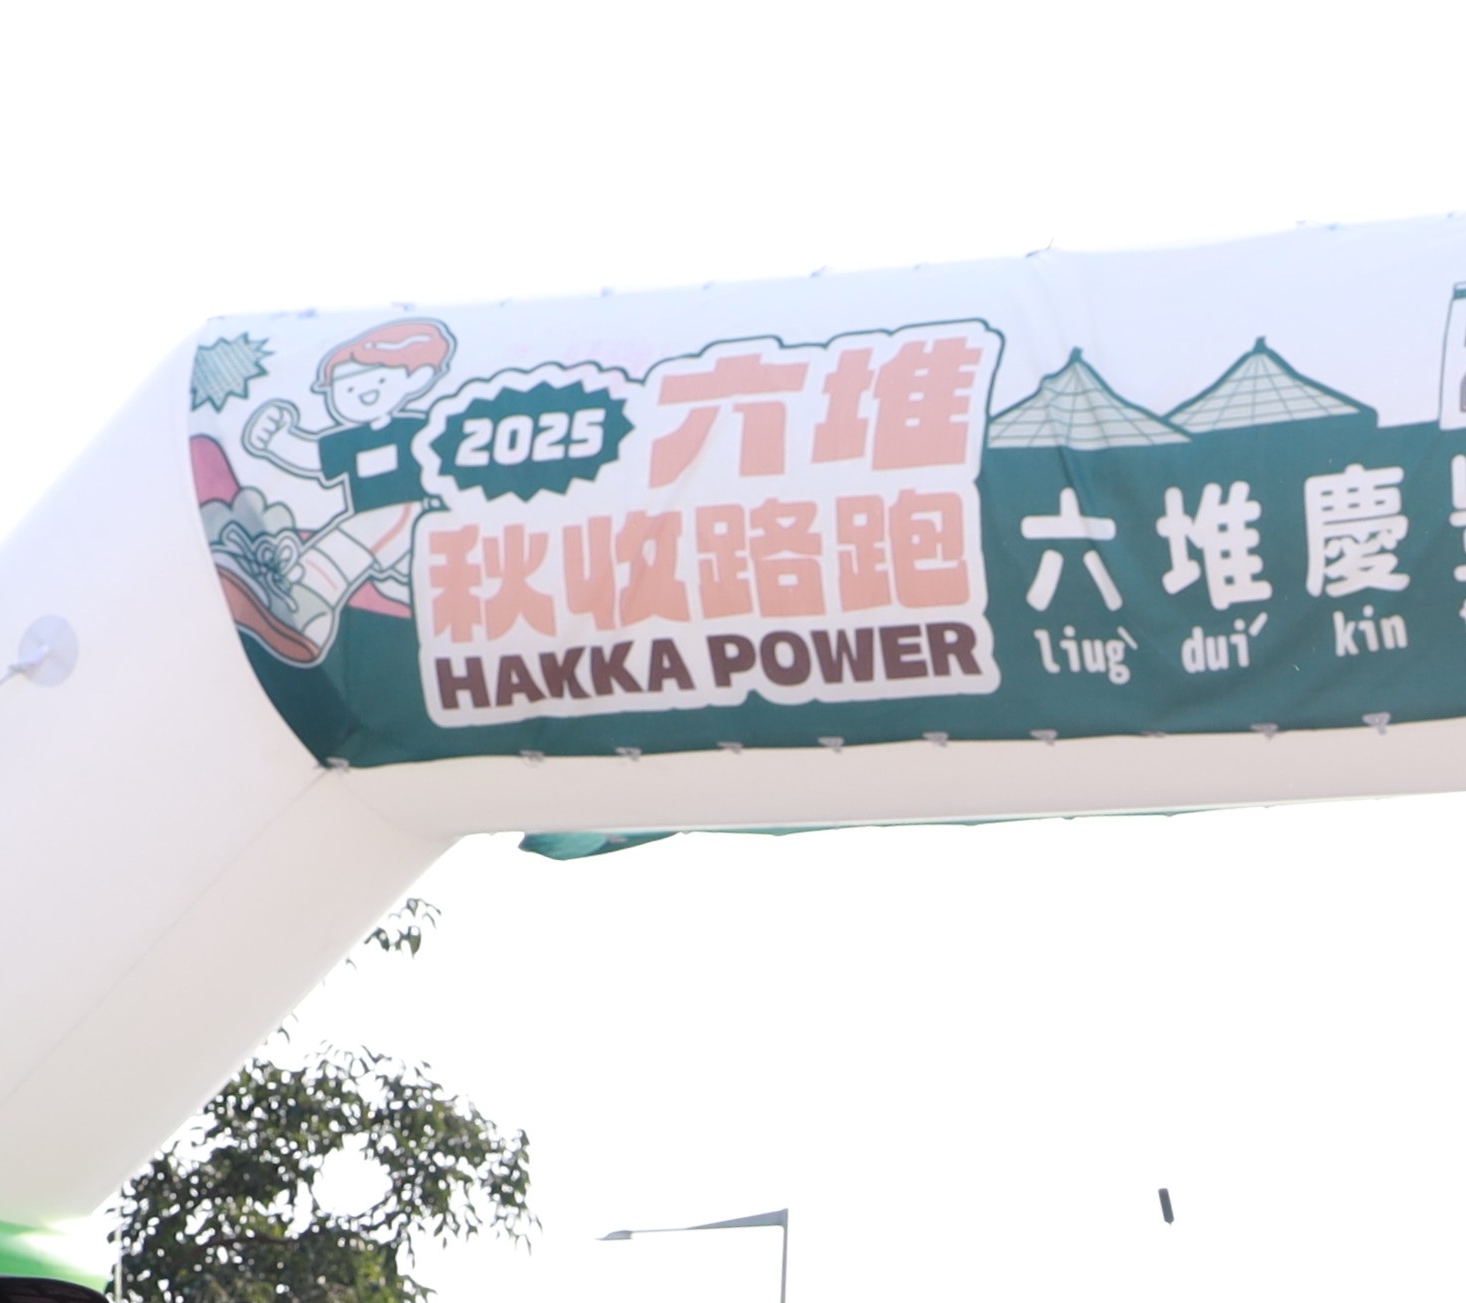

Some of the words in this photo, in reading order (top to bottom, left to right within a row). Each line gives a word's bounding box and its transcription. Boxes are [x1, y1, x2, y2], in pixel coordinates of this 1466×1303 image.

[455, 408, 608, 465] 2025
[646, 337, 984, 489] 六堆
[427, 488, 971, 645] 秋收路跑
[435, 632, 696, 713] HAKKA
[706, 621, 984, 689] POWER
[1334, 608, 1407, 657] kin
